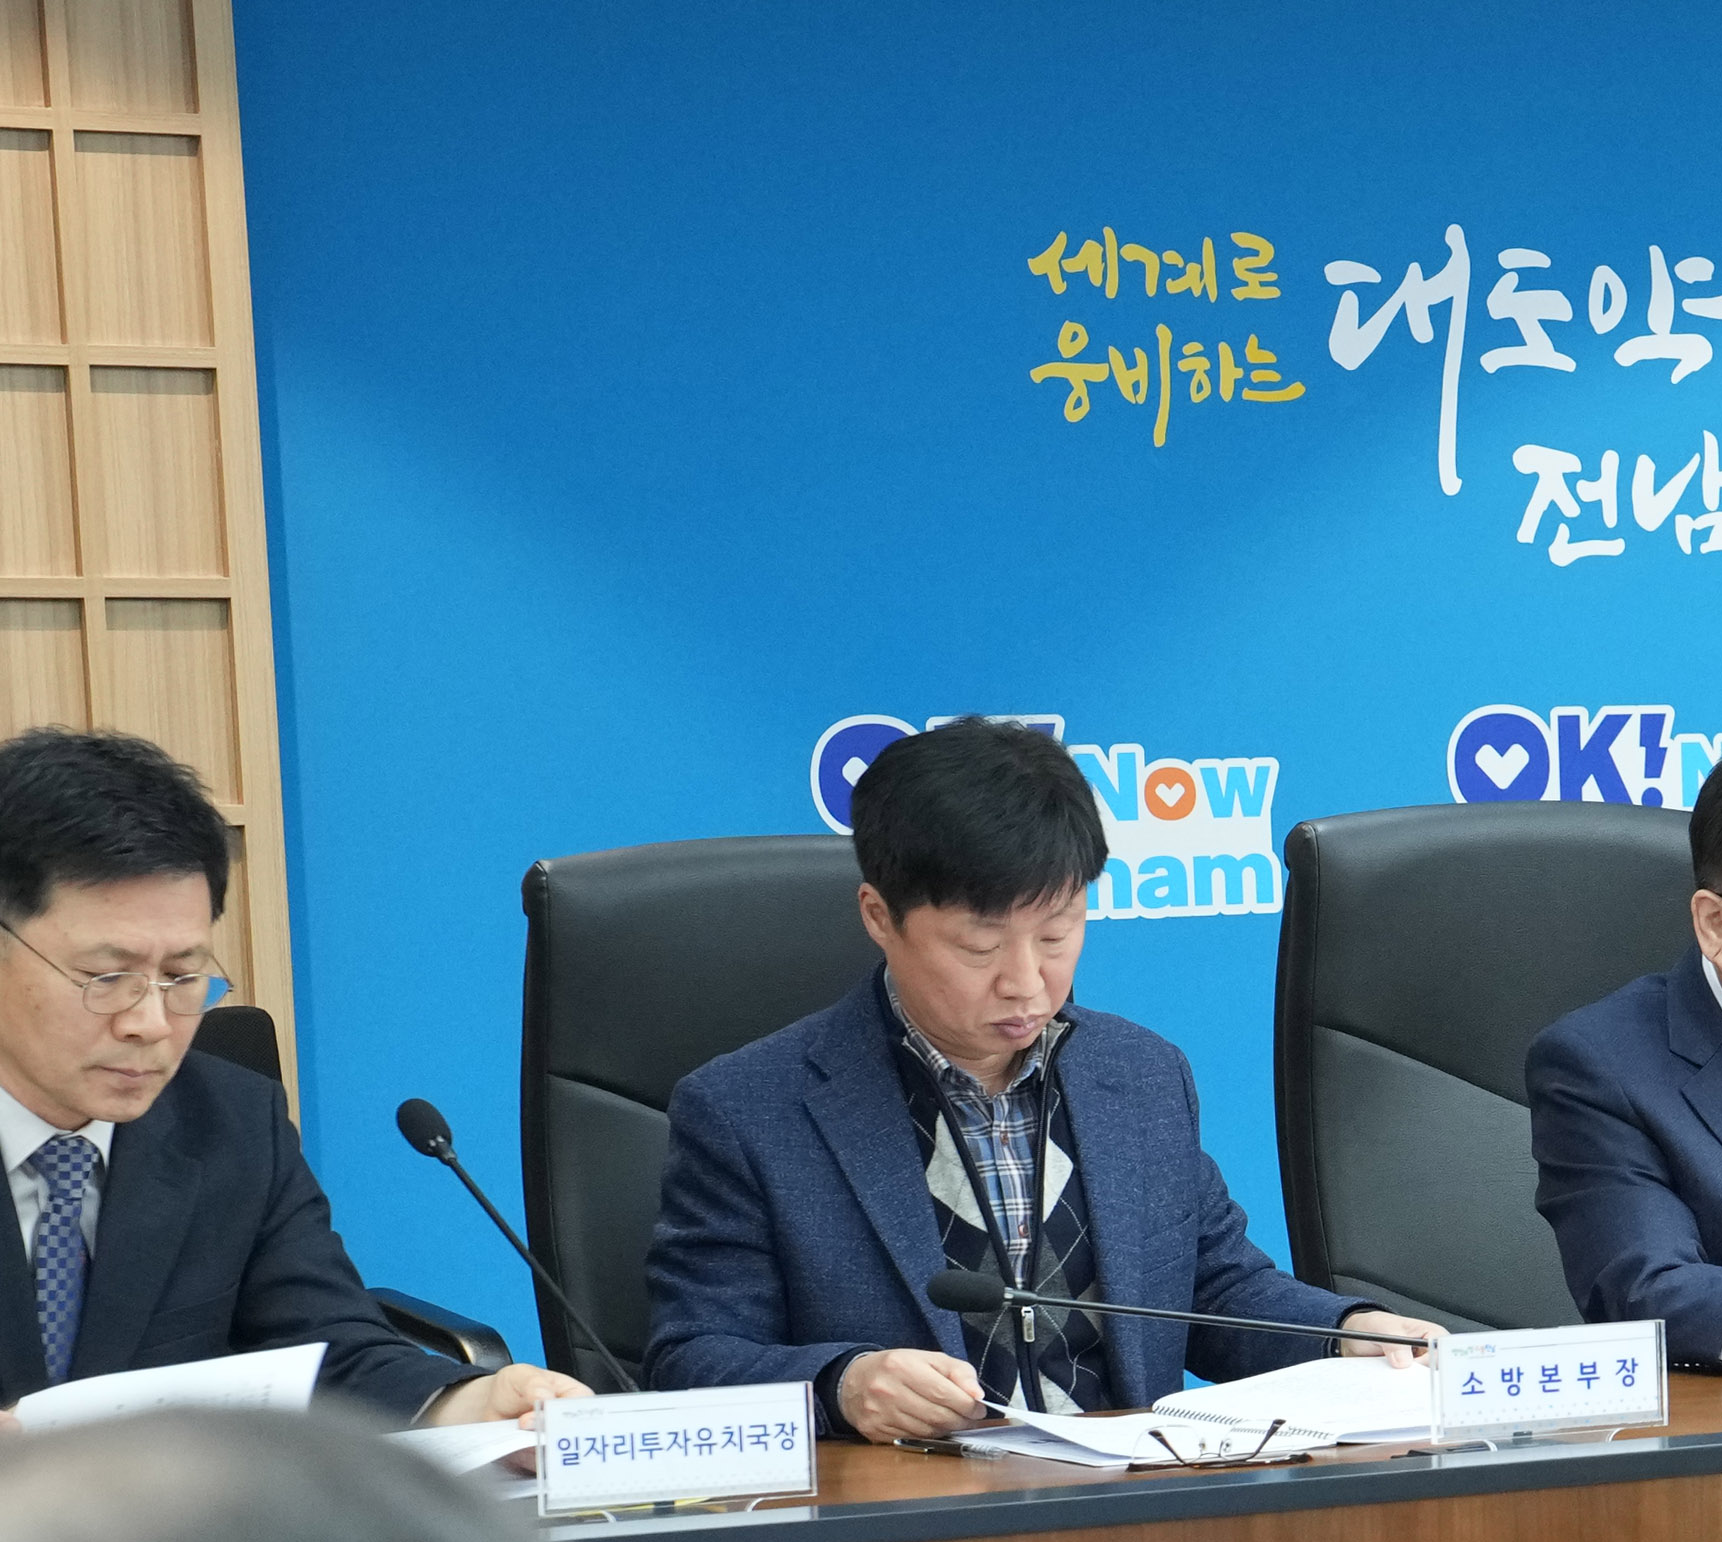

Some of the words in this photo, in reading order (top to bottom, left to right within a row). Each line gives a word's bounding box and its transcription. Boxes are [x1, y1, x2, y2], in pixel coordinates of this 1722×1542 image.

[1029, 228, 1281, 301] 세계로
[1030, 322, 1306, 447] 웅비하는
[1454, 713, 1668, 808] OK!
[1460, 1357, 1639, 1397] 소방본부장
[557, 1421, 798, 1467] 일자리투자유치국장
